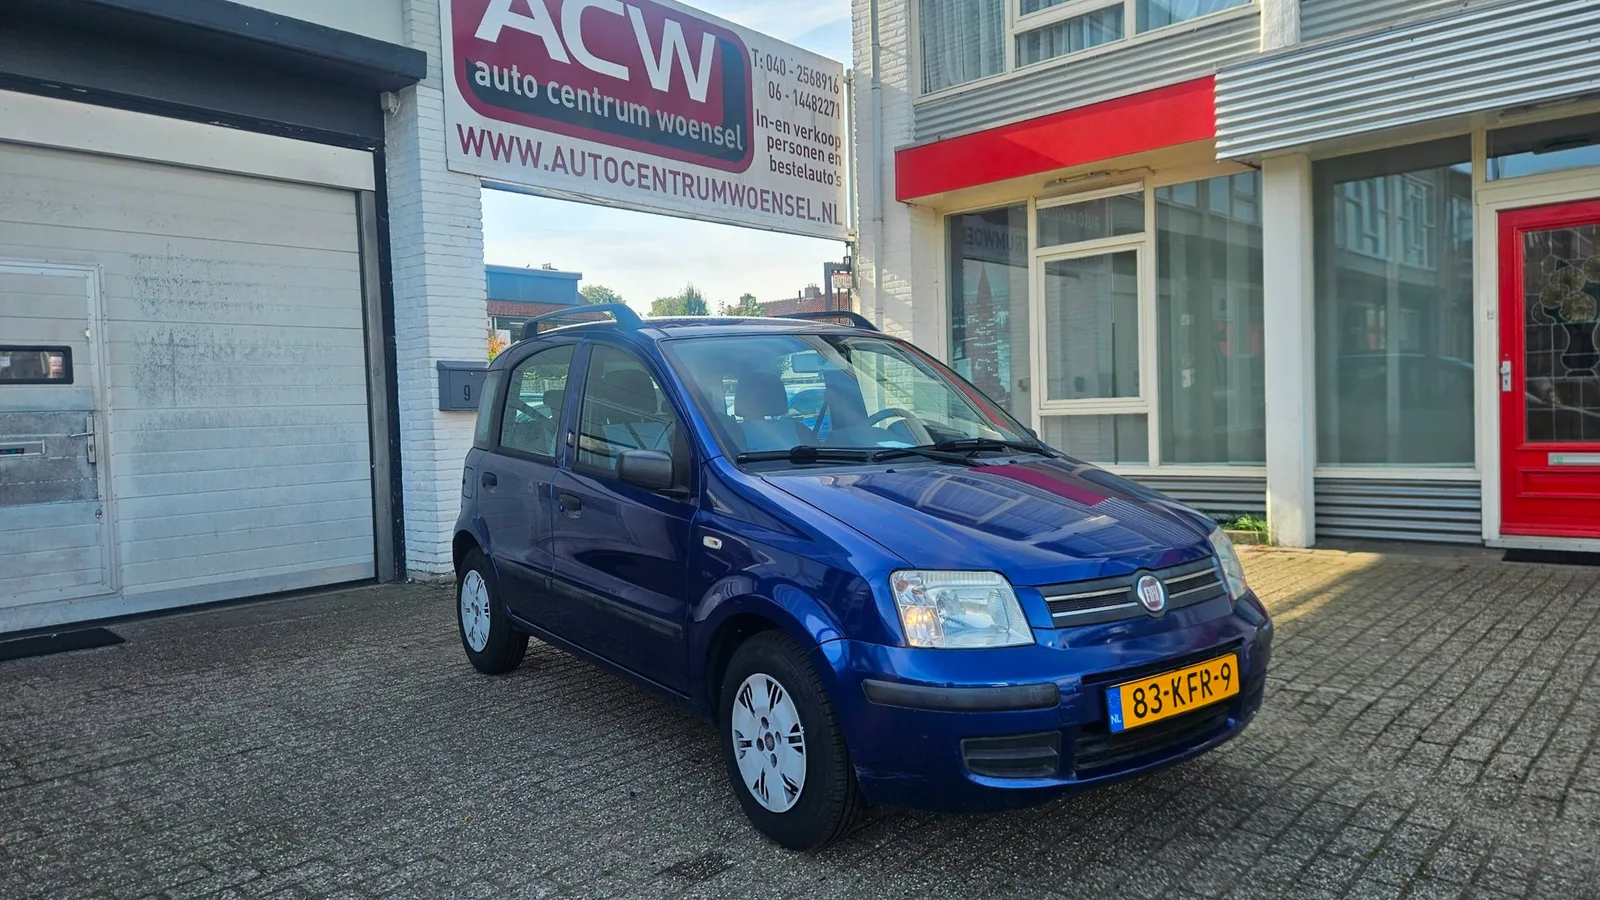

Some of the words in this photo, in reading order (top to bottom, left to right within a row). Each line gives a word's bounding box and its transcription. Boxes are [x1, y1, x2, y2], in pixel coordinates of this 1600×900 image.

[474, 0, 716, 103] ACW
[766, 53, 786, 76] 040
[797, 64, 839, 95] 2568916
[475, 60, 538, 99] auto
[547, 81, 650, 128] centrum
[656, 109, 743, 151] woensel
[768, 81, 782, 101] 06
[793, 88, 840, 120] 14482271
[756, 109, 790, 135] In-en
[794, 124, 841, 152] verkoop
[767, 135, 825, 162] personen
[828, 152, 842, 167] en
[456, 123, 843, 226] WWW.AUTOCENTRUMWOENSEL.NL
[769, 154, 842, 187] bestelauto's
[463, 384, 471, 402] 9
[1132, 662, 1231, 719] 83-KFR-9
[1110, 714, 1122, 724] NL
